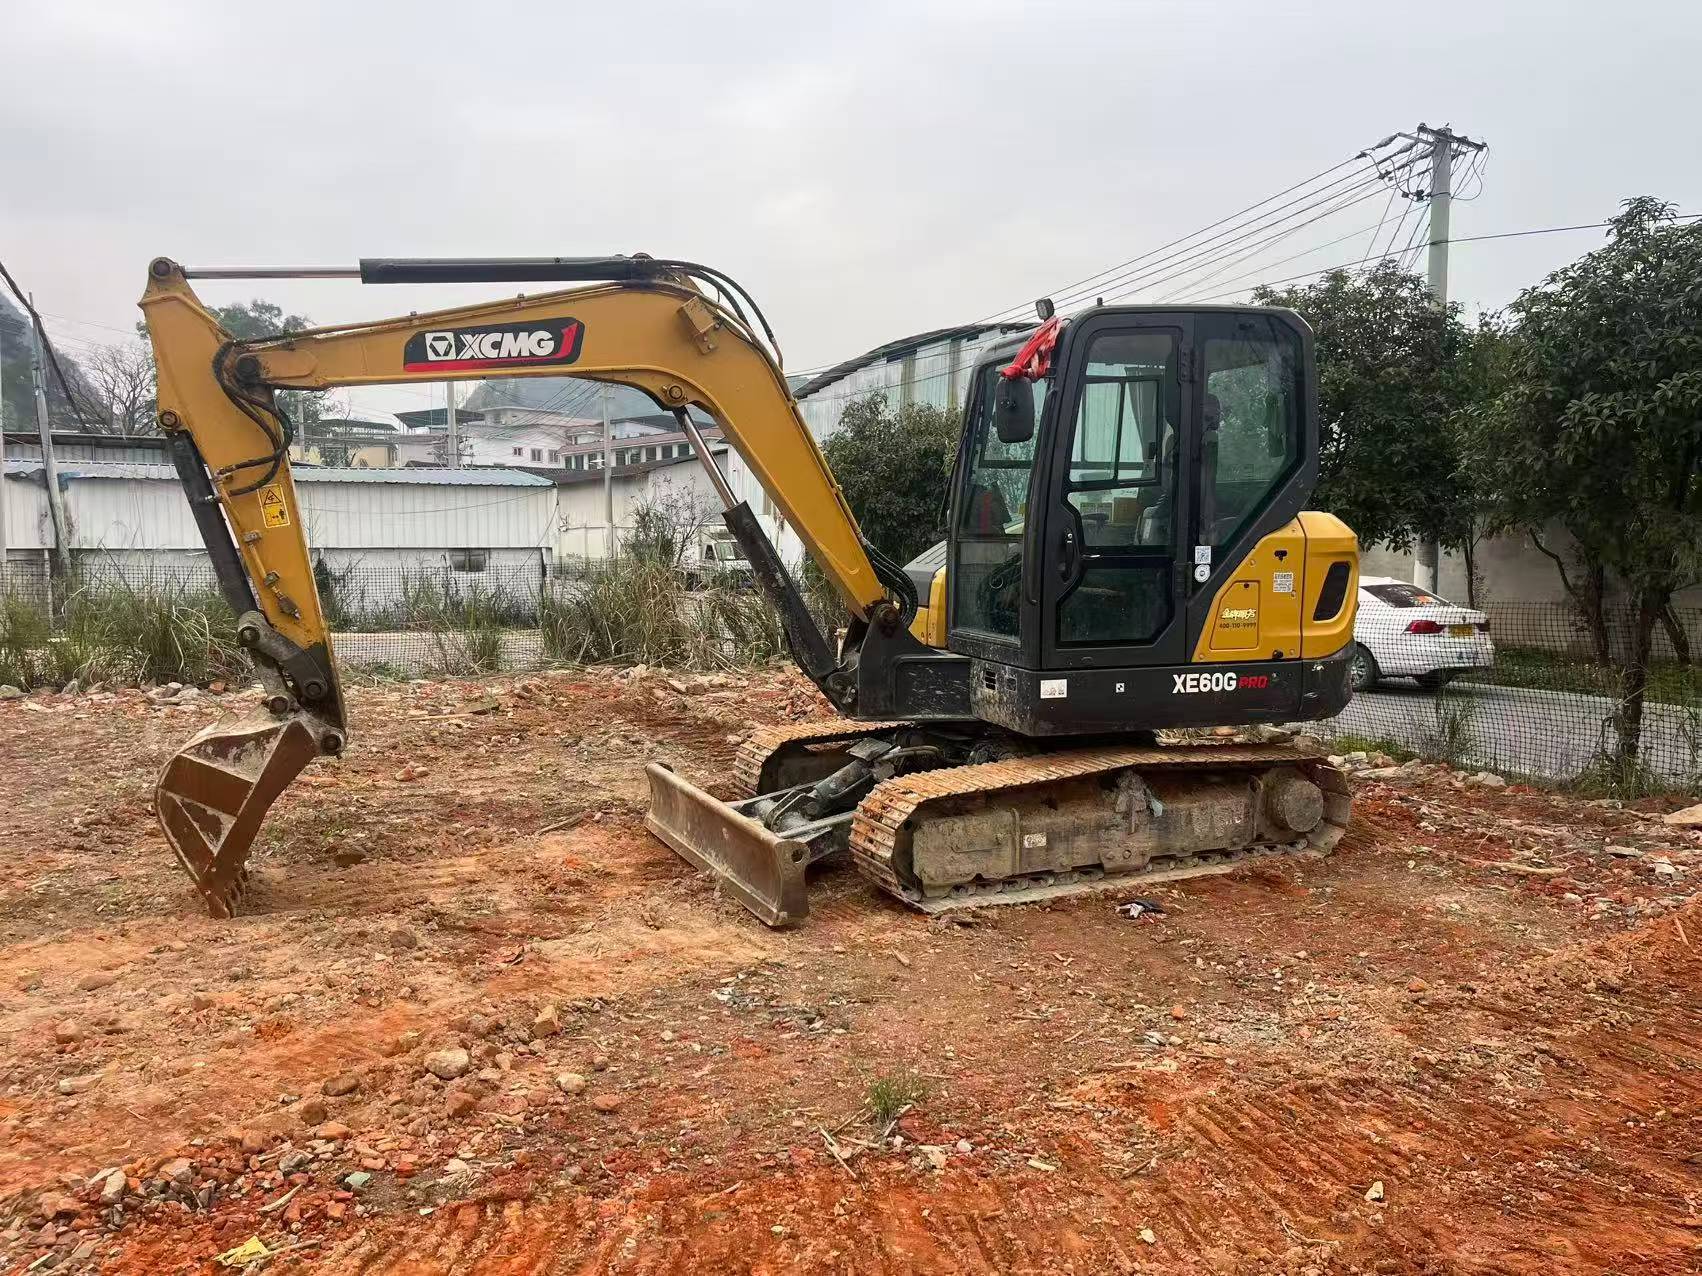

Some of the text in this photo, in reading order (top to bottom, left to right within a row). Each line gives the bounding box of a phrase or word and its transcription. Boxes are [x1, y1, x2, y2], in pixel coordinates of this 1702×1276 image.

[457, 330, 555, 360] XCMG
[1172, 672, 1269, 694] XE60G PRO
